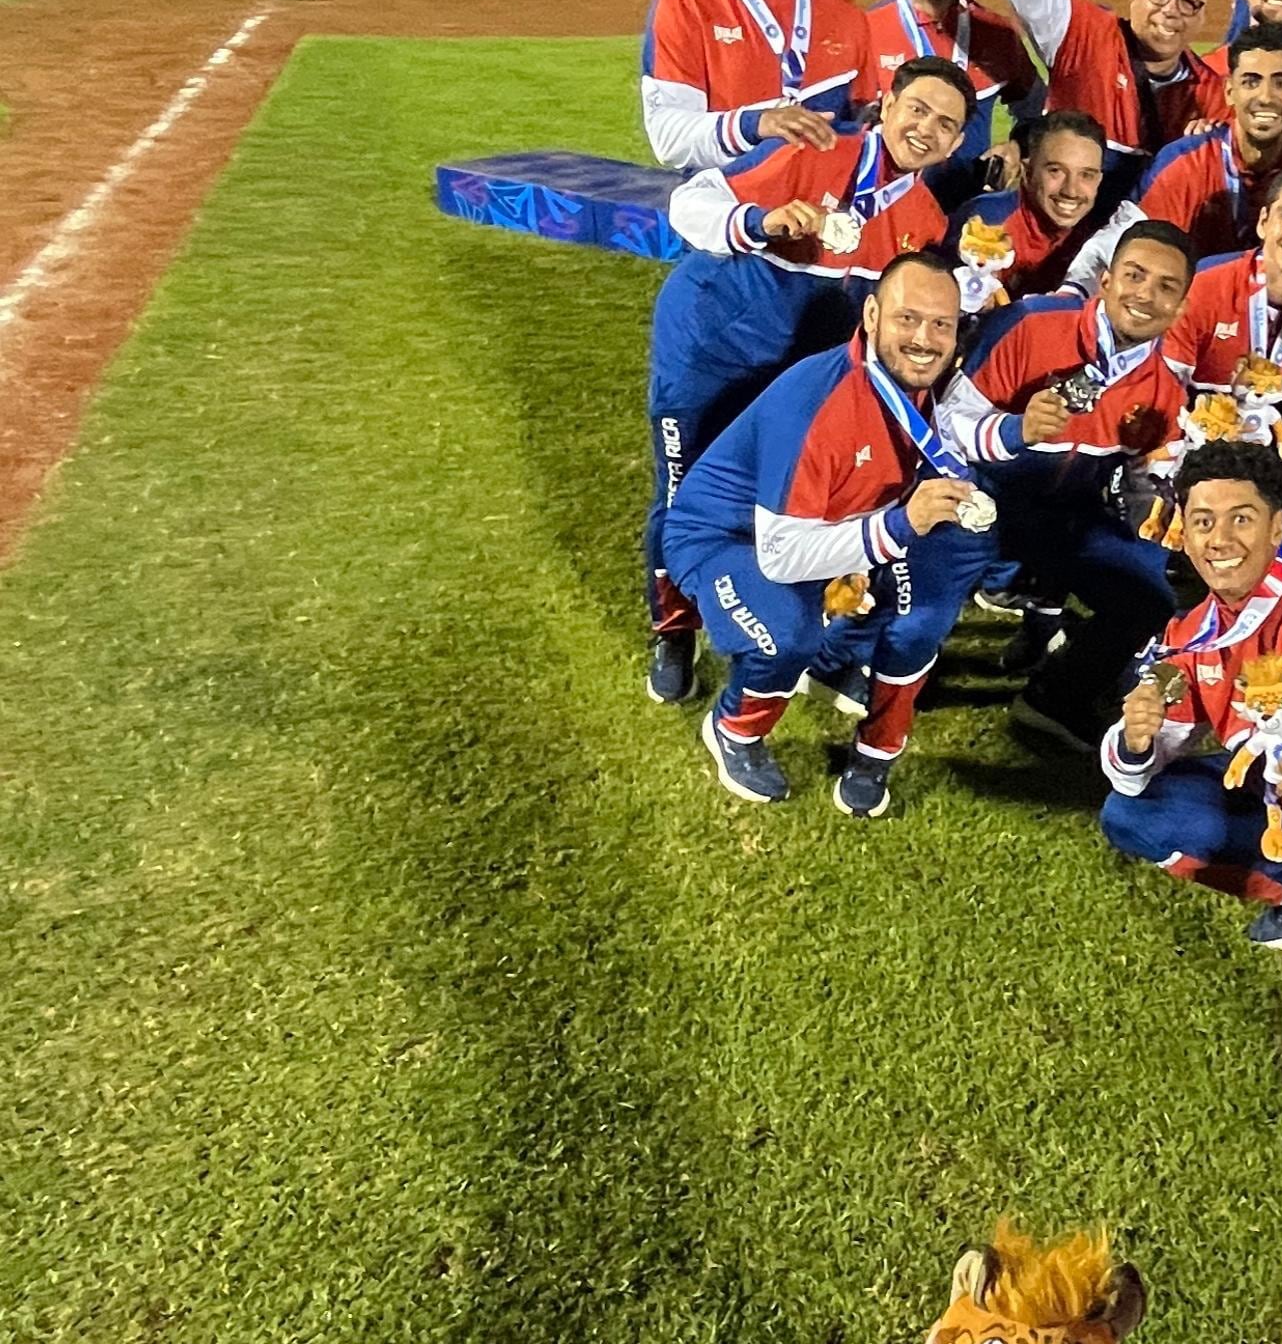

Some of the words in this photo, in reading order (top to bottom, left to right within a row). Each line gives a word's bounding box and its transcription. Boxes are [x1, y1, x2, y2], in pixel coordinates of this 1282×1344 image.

[661, 417, 682, 458] RICA
[892, 562, 911, 616] COSTA
[731, 606, 777, 656] COSTA
